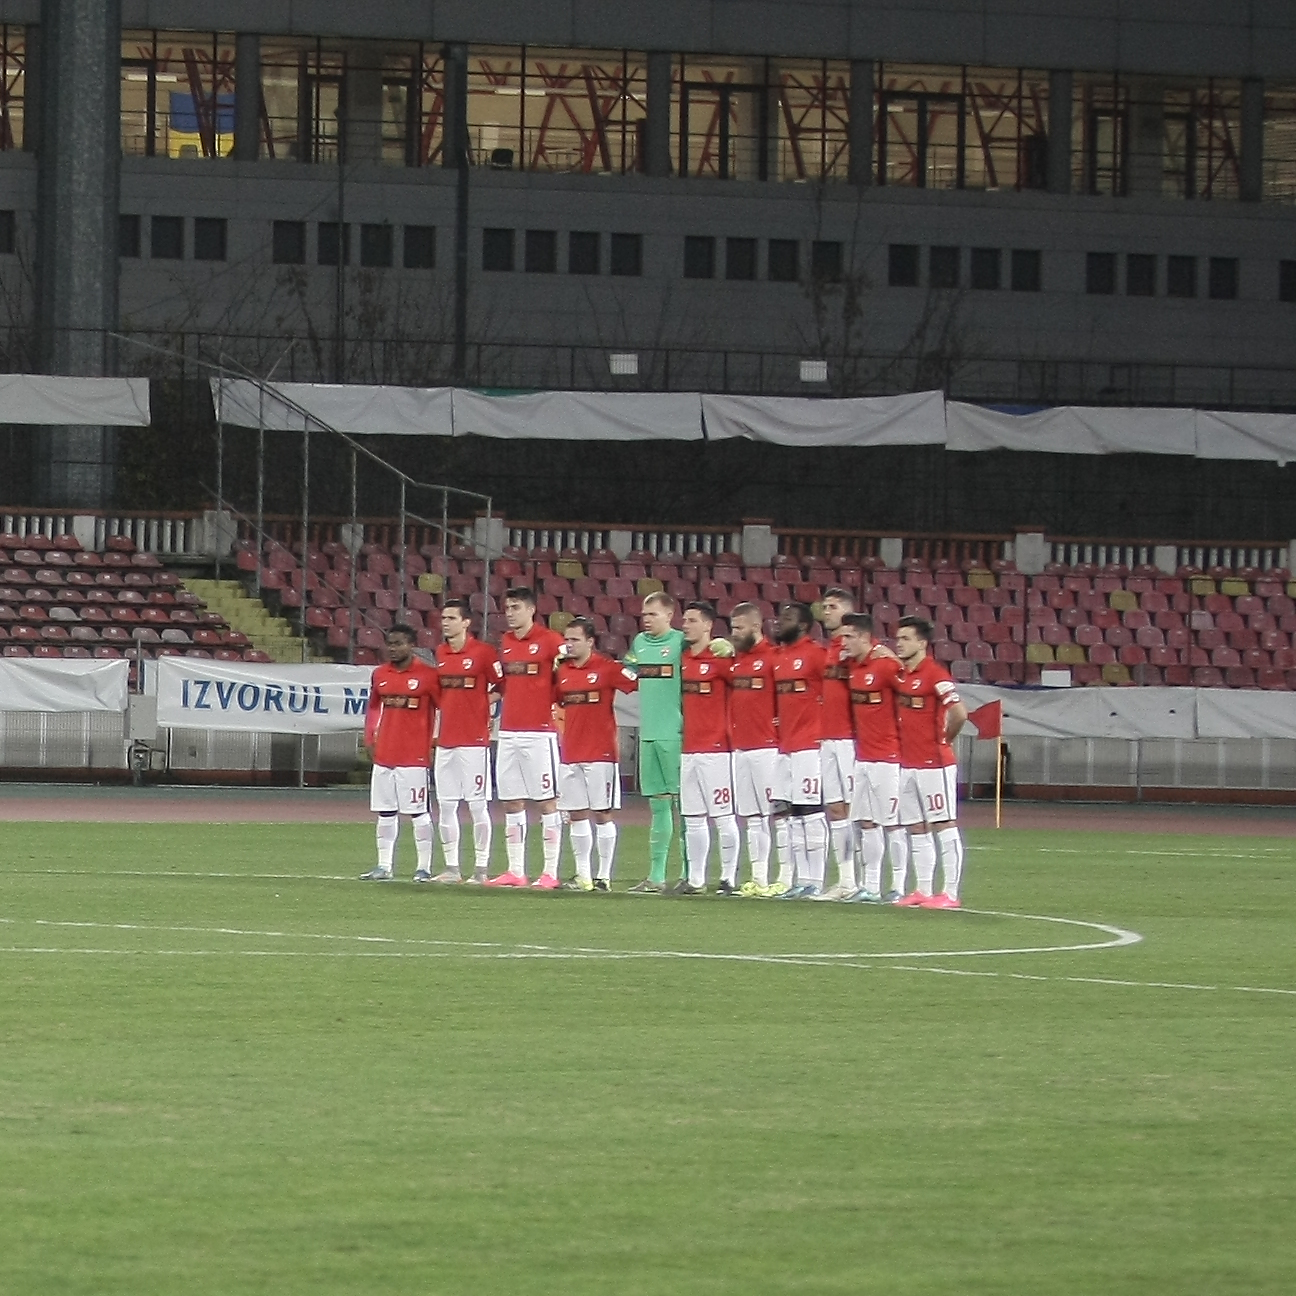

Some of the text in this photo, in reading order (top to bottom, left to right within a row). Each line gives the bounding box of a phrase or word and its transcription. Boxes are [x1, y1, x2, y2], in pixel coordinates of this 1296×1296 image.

[180, 678, 329, 714] IZVORUL
[474, 774, 484, 791] 9
[541, 773, 551, 790] 5
[802, 778, 820, 795] 31
[409, 787, 426, 804] 14
[714, 787, 731, 805] 28
[926, 792, 945, 811] 10
[889, 797, 899, 814] 7
